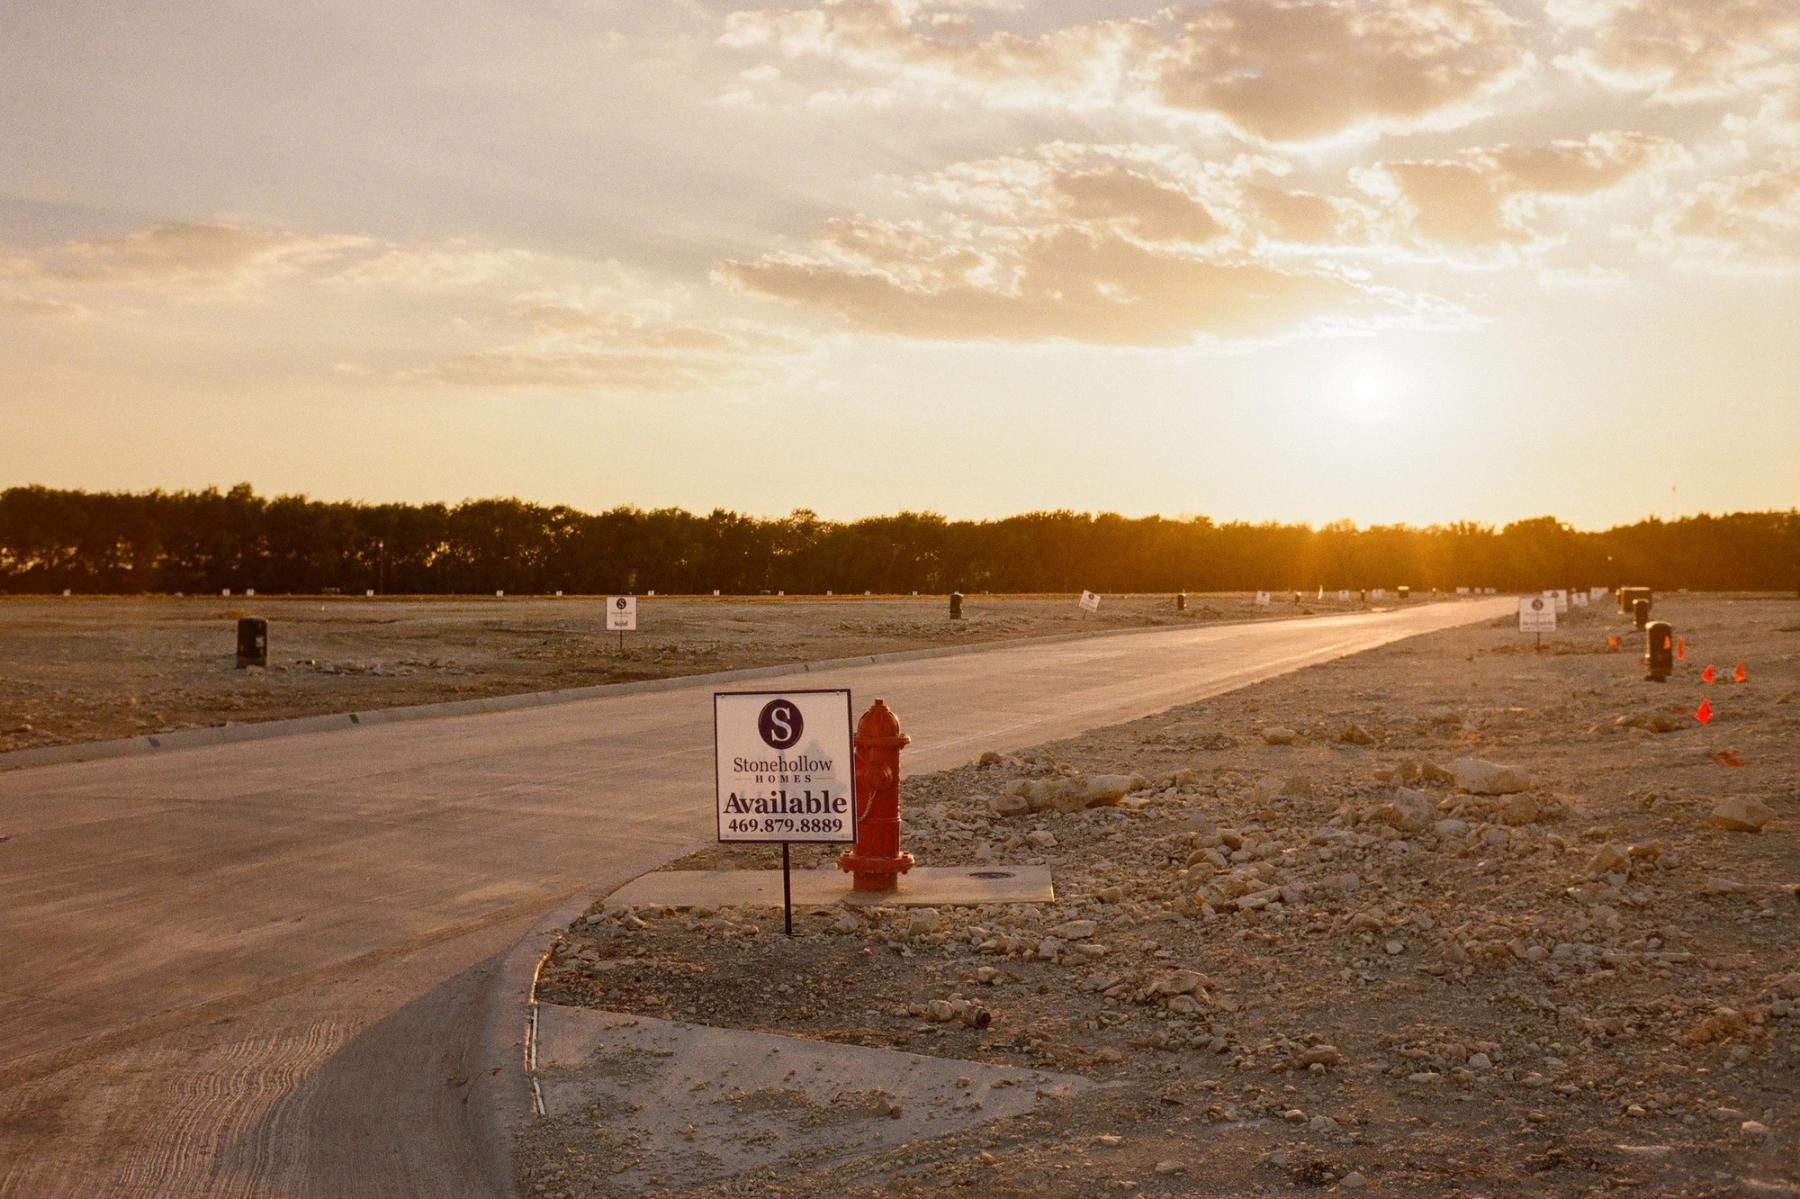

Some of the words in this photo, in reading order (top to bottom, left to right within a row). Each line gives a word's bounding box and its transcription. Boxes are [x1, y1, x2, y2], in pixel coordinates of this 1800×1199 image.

[771, 707, 792, 742] S
[733, 755, 833, 772] Stonehollow
[755, 774, 812, 783] HOMES
[723, 790, 848, 814] Available
[728, 818, 843, 833] 469.879.8889
